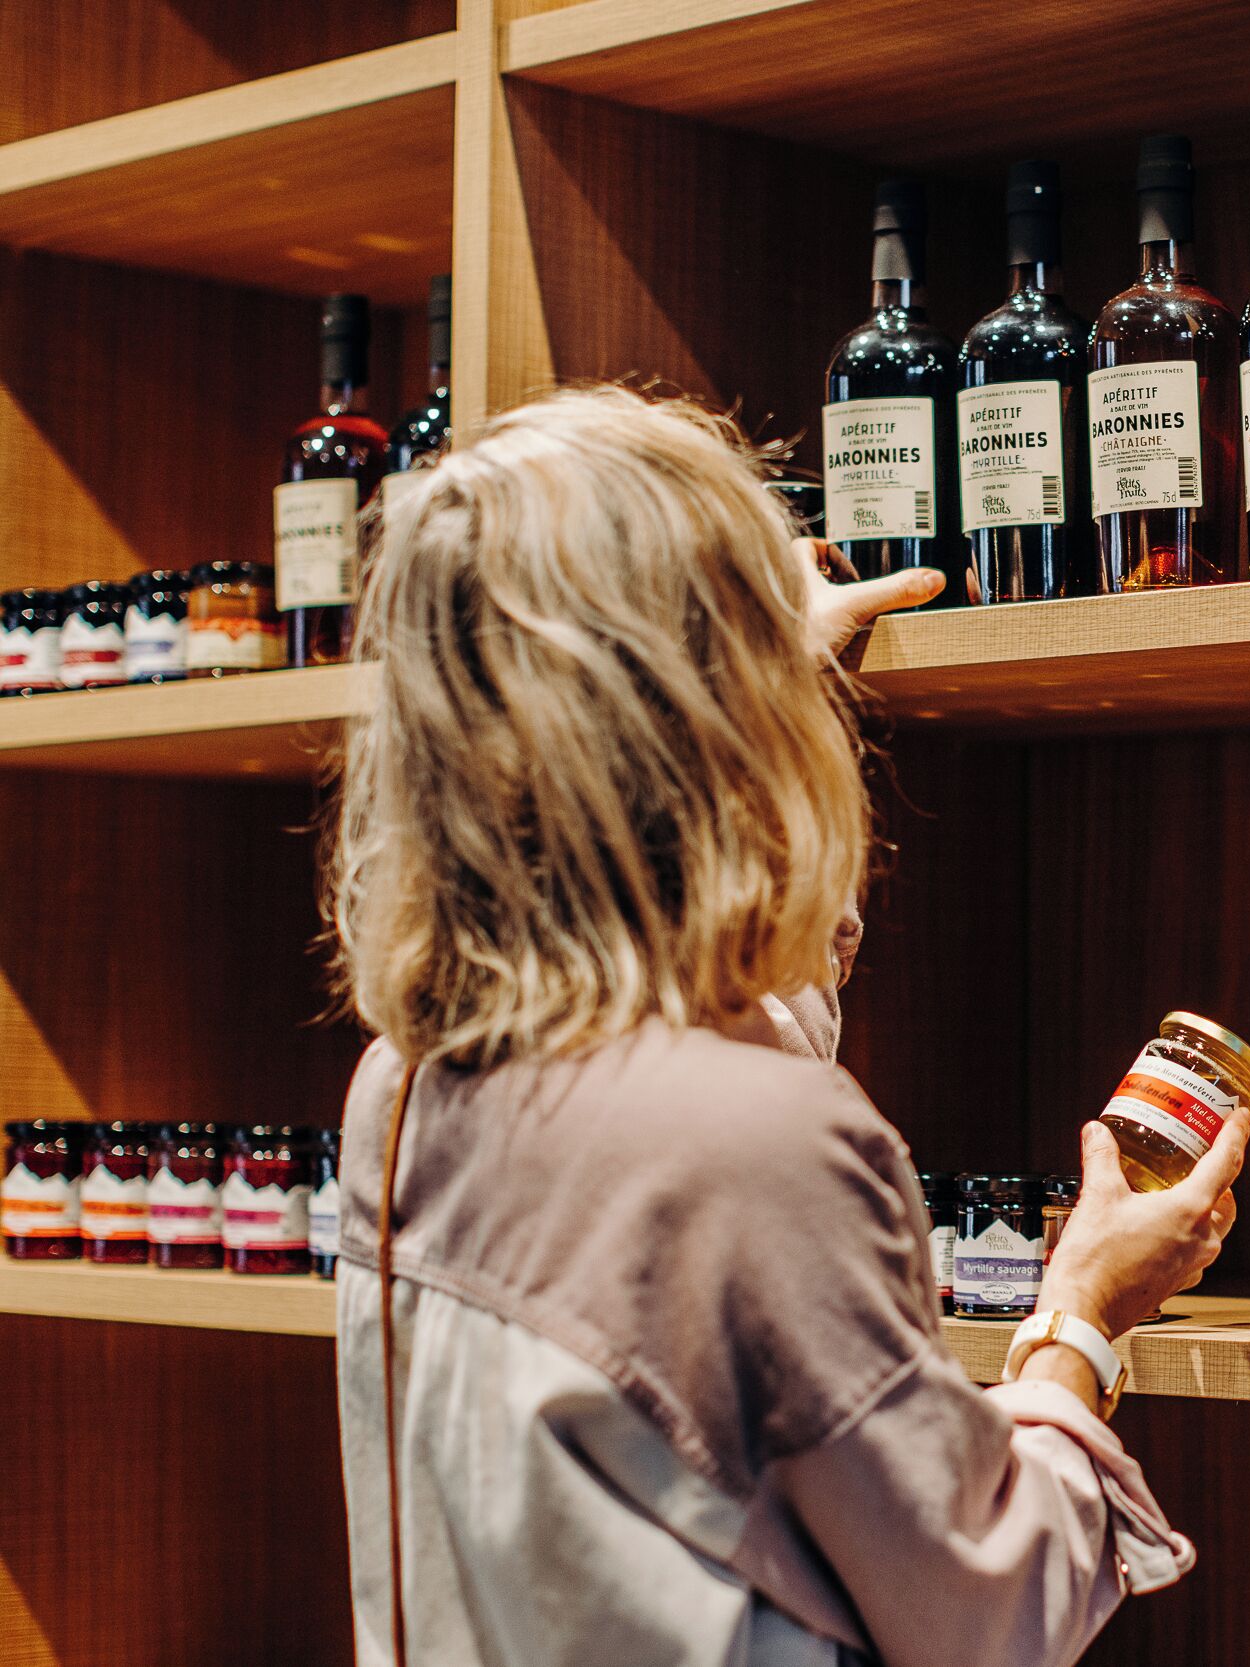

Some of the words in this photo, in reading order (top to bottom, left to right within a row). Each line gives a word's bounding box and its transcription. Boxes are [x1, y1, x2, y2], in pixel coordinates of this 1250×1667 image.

[1103, 386, 1158, 404] APÉRITIF
[970, 407, 1022, 423] APÉRITIF
[1092, 412, 1184, 439] BARONNIES
[841, 422, 897, 437] APÉRITIF
[961, 431, 1048, 457] BARONNIES
[829, 447, 921, 469] BARONNIES
[1184, 1111, 1212, 1137] Pyrénées
[1190, 1102, 1206, 1118] Miel
[1205, 1114, 1217, 1126] des
[963, 1263, 995, 1275] Myrtille
[997, 1265, 1039, 1277] sauvage
